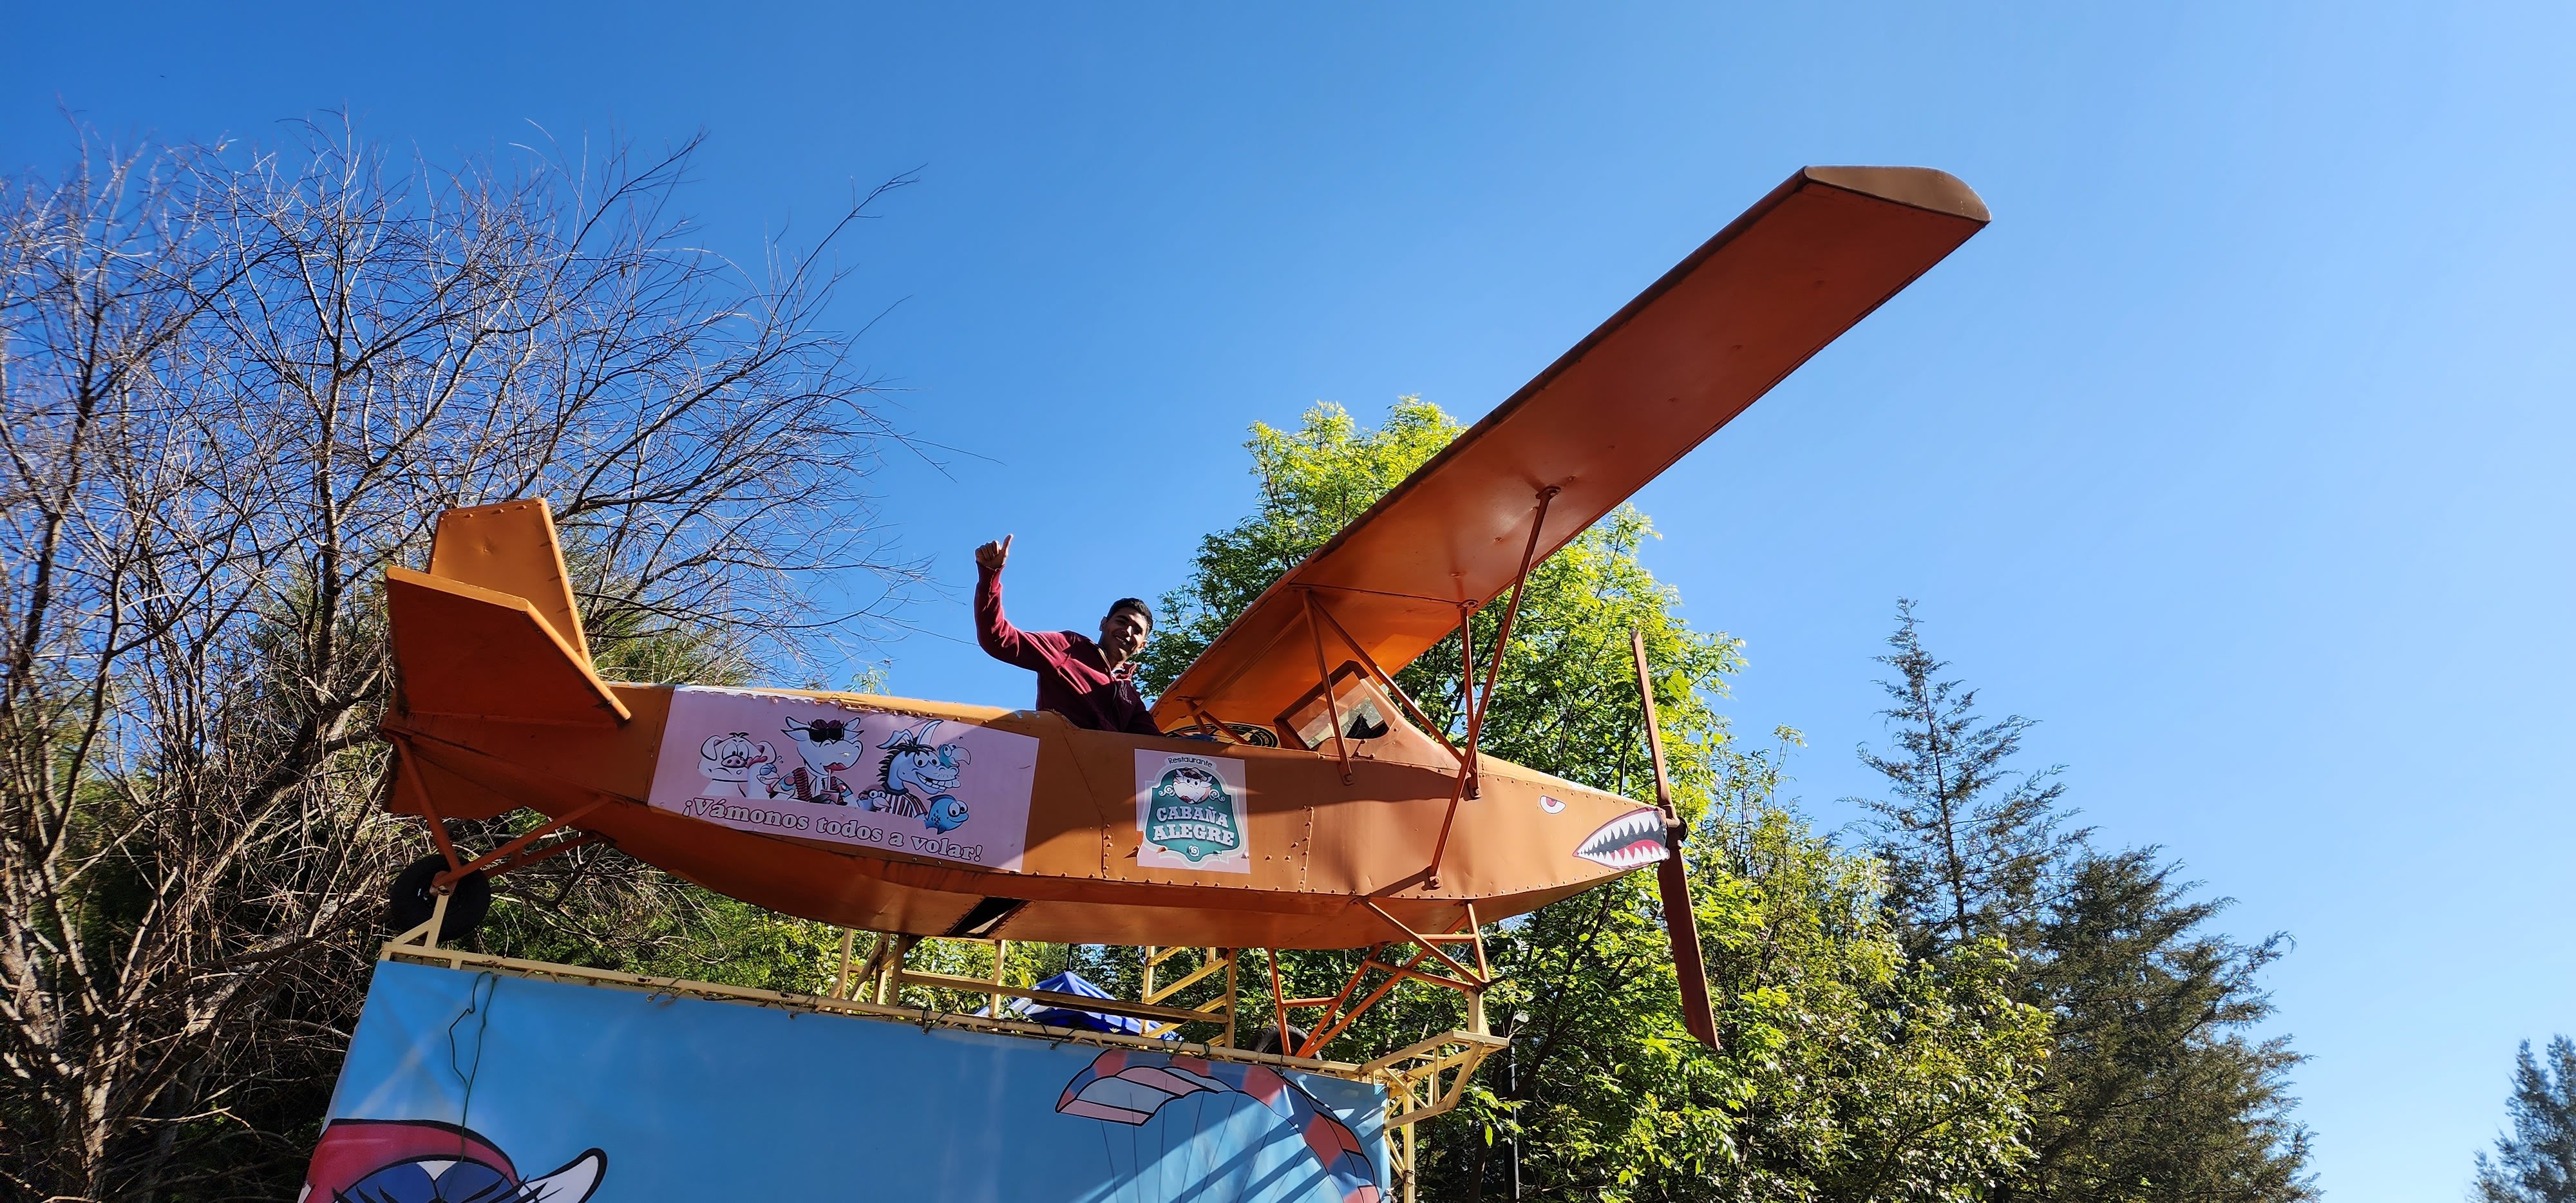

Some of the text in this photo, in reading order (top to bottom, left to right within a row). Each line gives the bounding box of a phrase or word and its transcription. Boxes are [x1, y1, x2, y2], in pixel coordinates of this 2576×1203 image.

[1168, 756, 1213, 768] Restaurante
[1156, 806, 1229, 828] CABAÑA
[682, 797, 983, 862] ¡Vámonos todos a volar!
[1153, 824, 1235, 847] ALEGRE
